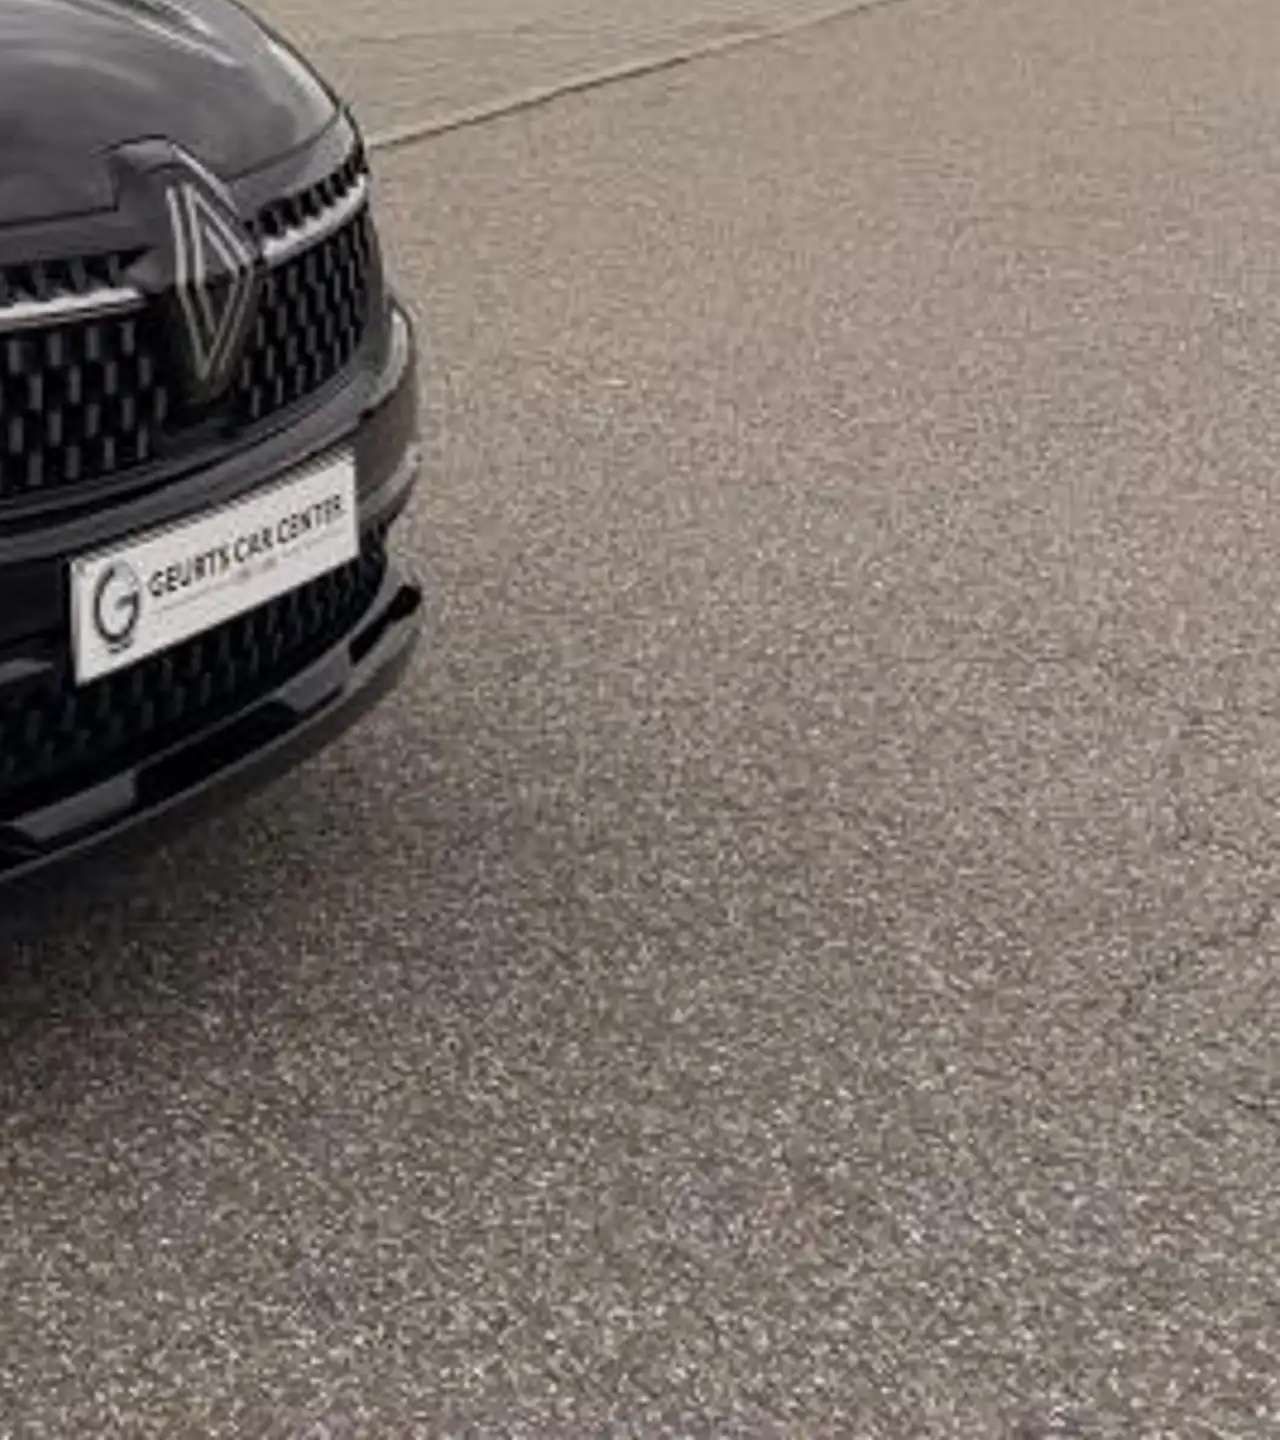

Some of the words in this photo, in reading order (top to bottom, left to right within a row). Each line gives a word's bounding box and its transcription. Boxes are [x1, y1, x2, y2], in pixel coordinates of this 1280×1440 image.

[149, 544, 230, 597] GEURTS
[233, 526, 274, 564] CAR
[277, 492, 344, 545] CENTER
